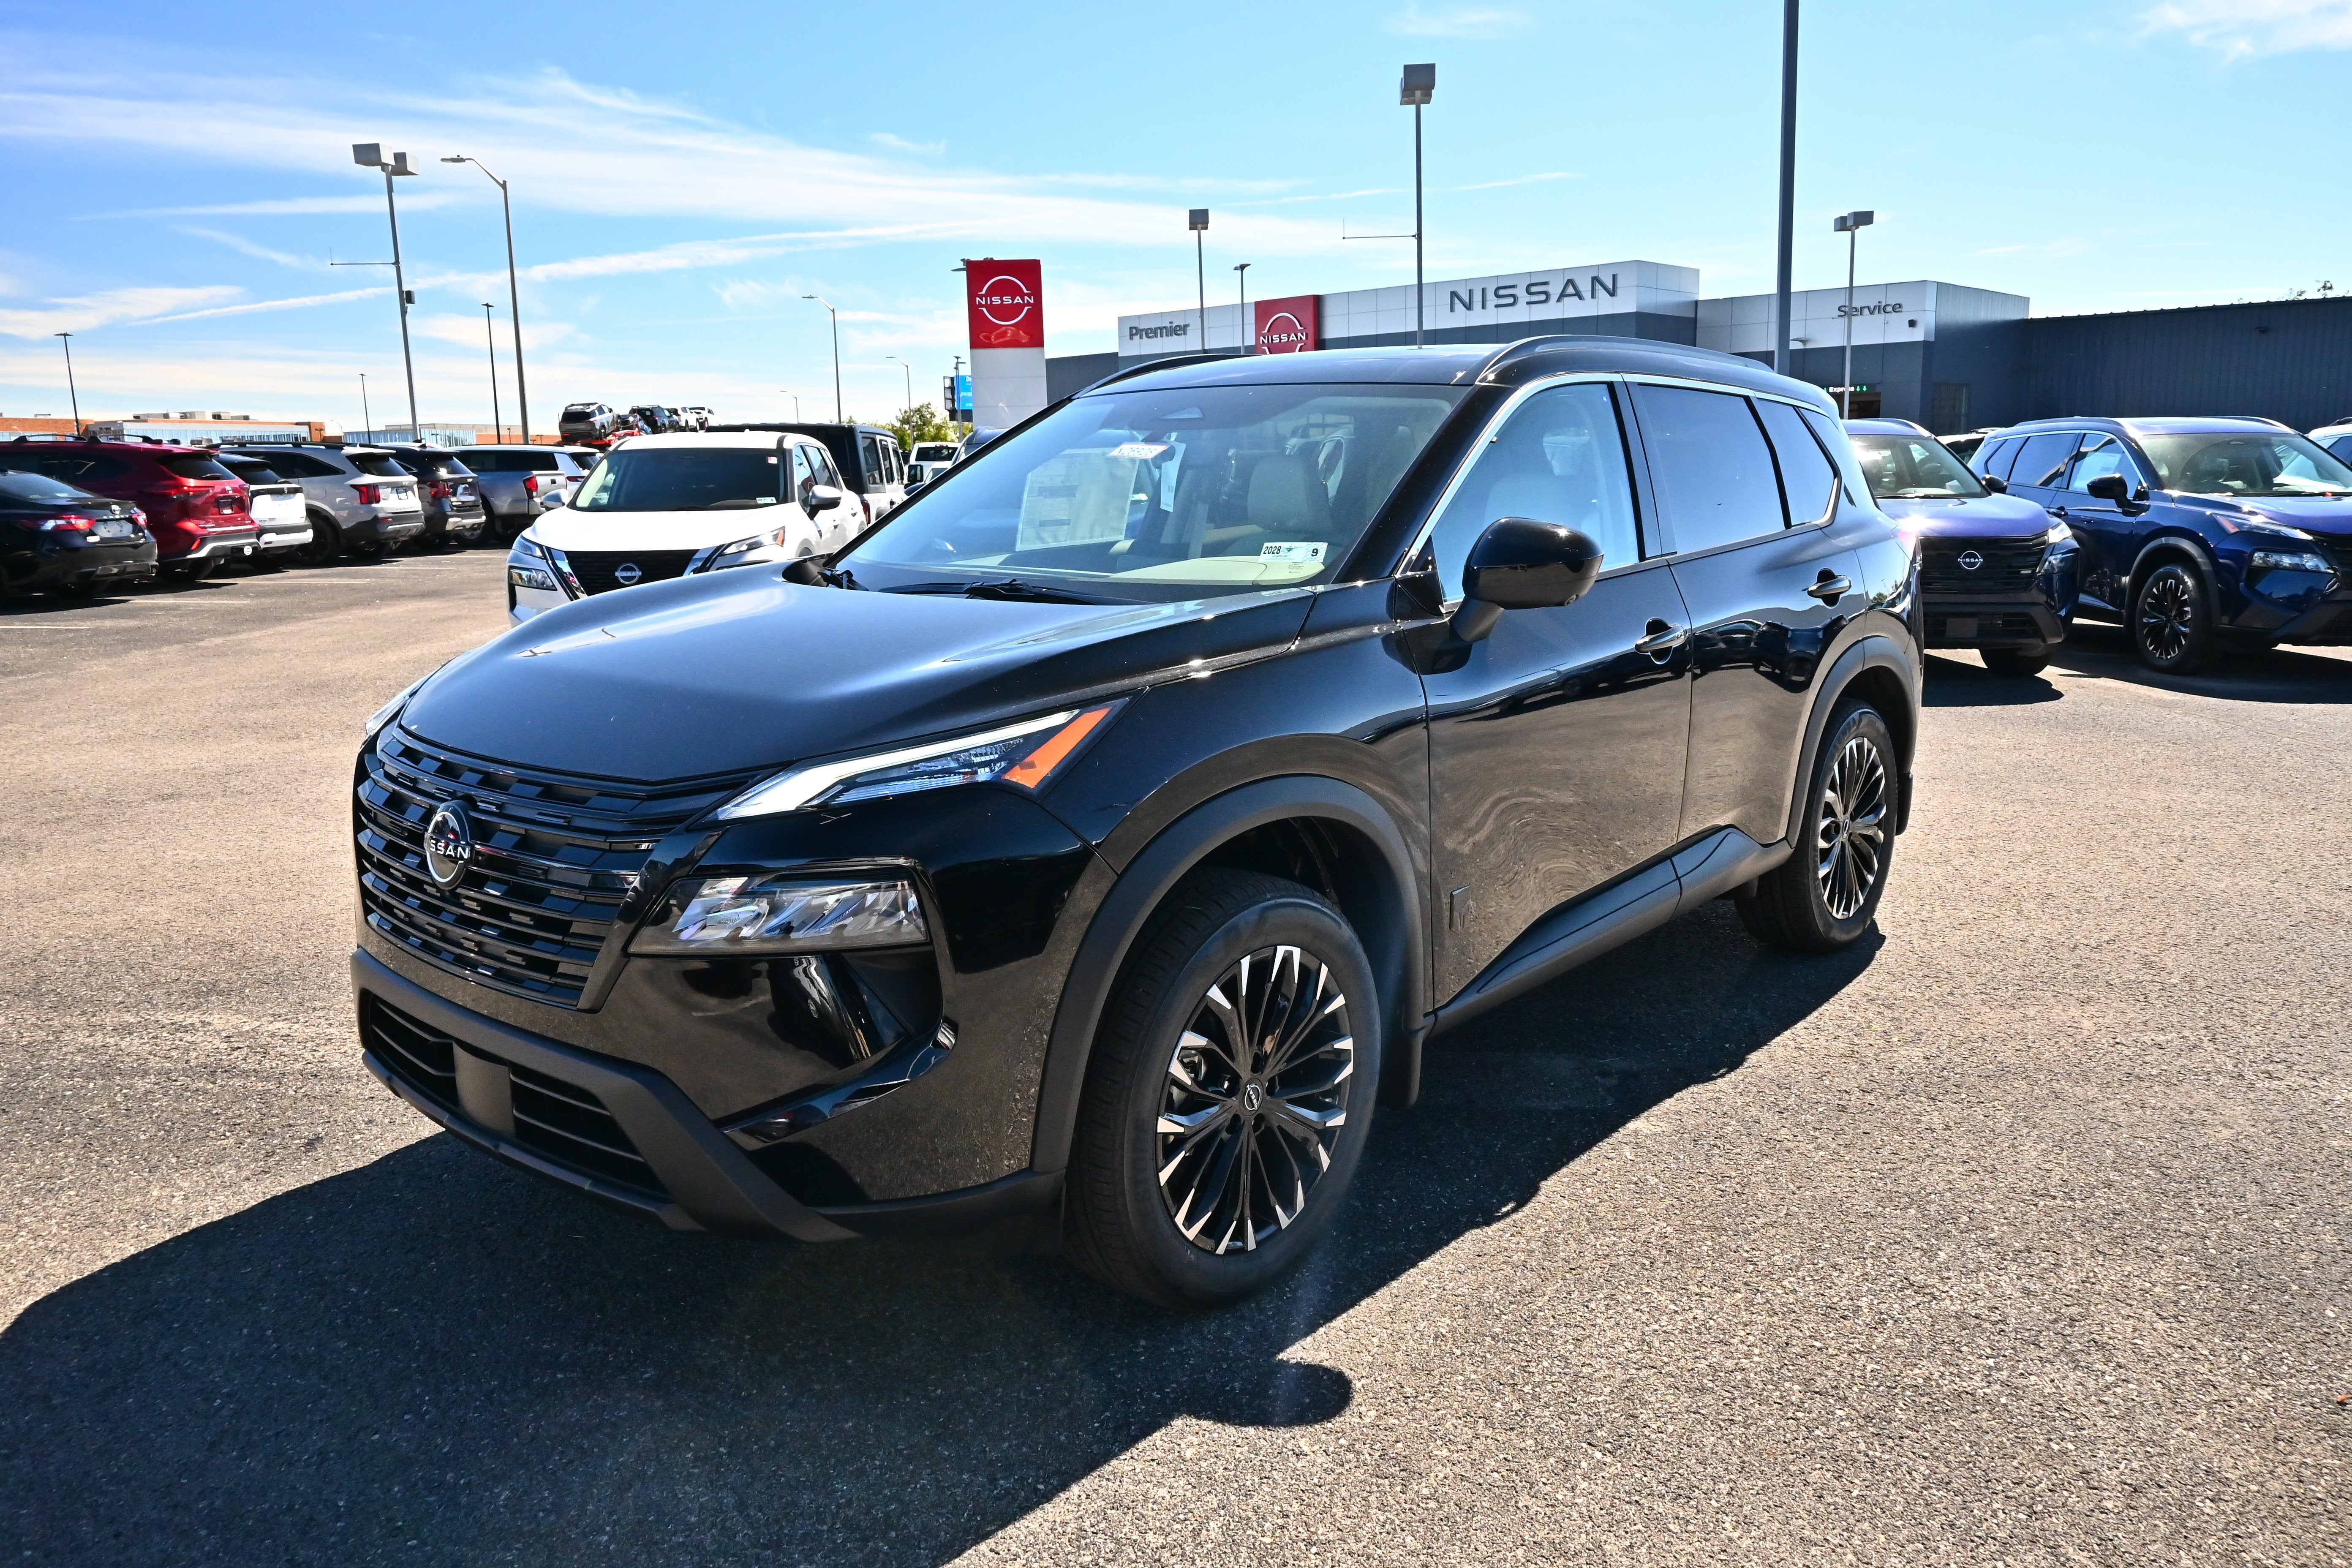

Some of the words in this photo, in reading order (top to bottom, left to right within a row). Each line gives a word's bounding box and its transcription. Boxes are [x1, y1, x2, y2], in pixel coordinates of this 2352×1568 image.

[1450, 274, 1617, 312] NISSAN
[976, 296, 1034, 305] NISSAN
[1838, 301, 1903, 317] Service
[1129, 321, 1190, 340] Premier
[1260, 332, 1306, 344] NISSAN
[1263, 546, 1282, 554] 2028
[1311, 548, 1319, 557] 9
